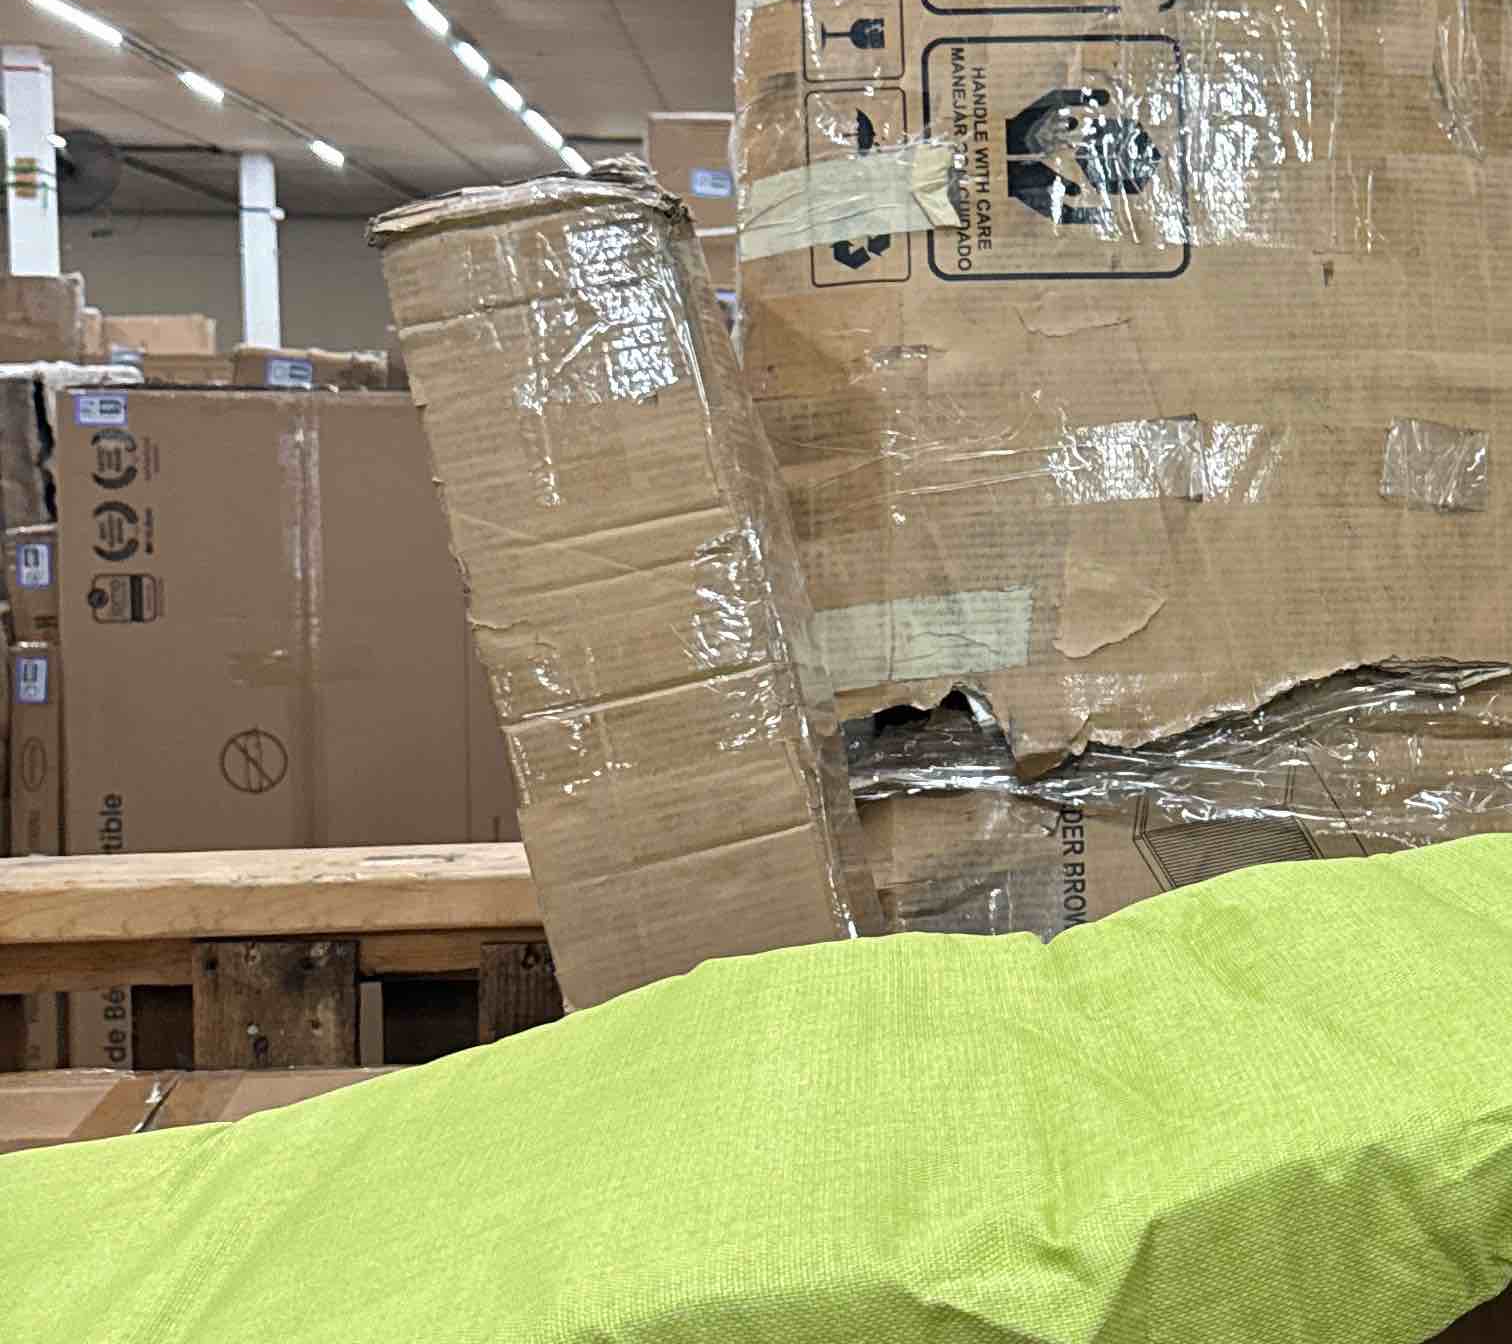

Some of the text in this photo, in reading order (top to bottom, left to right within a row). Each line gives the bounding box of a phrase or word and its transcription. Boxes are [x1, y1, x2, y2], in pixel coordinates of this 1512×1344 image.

[951, 46, 968, 136] MANEJAR
[972, 66, 992, 251] HANDLE WITH CARE
[98, 792, 124, 853] tible
[1062, 809, 1087, 929] DER BROW
[102, 988, 126, 1022] Bé
